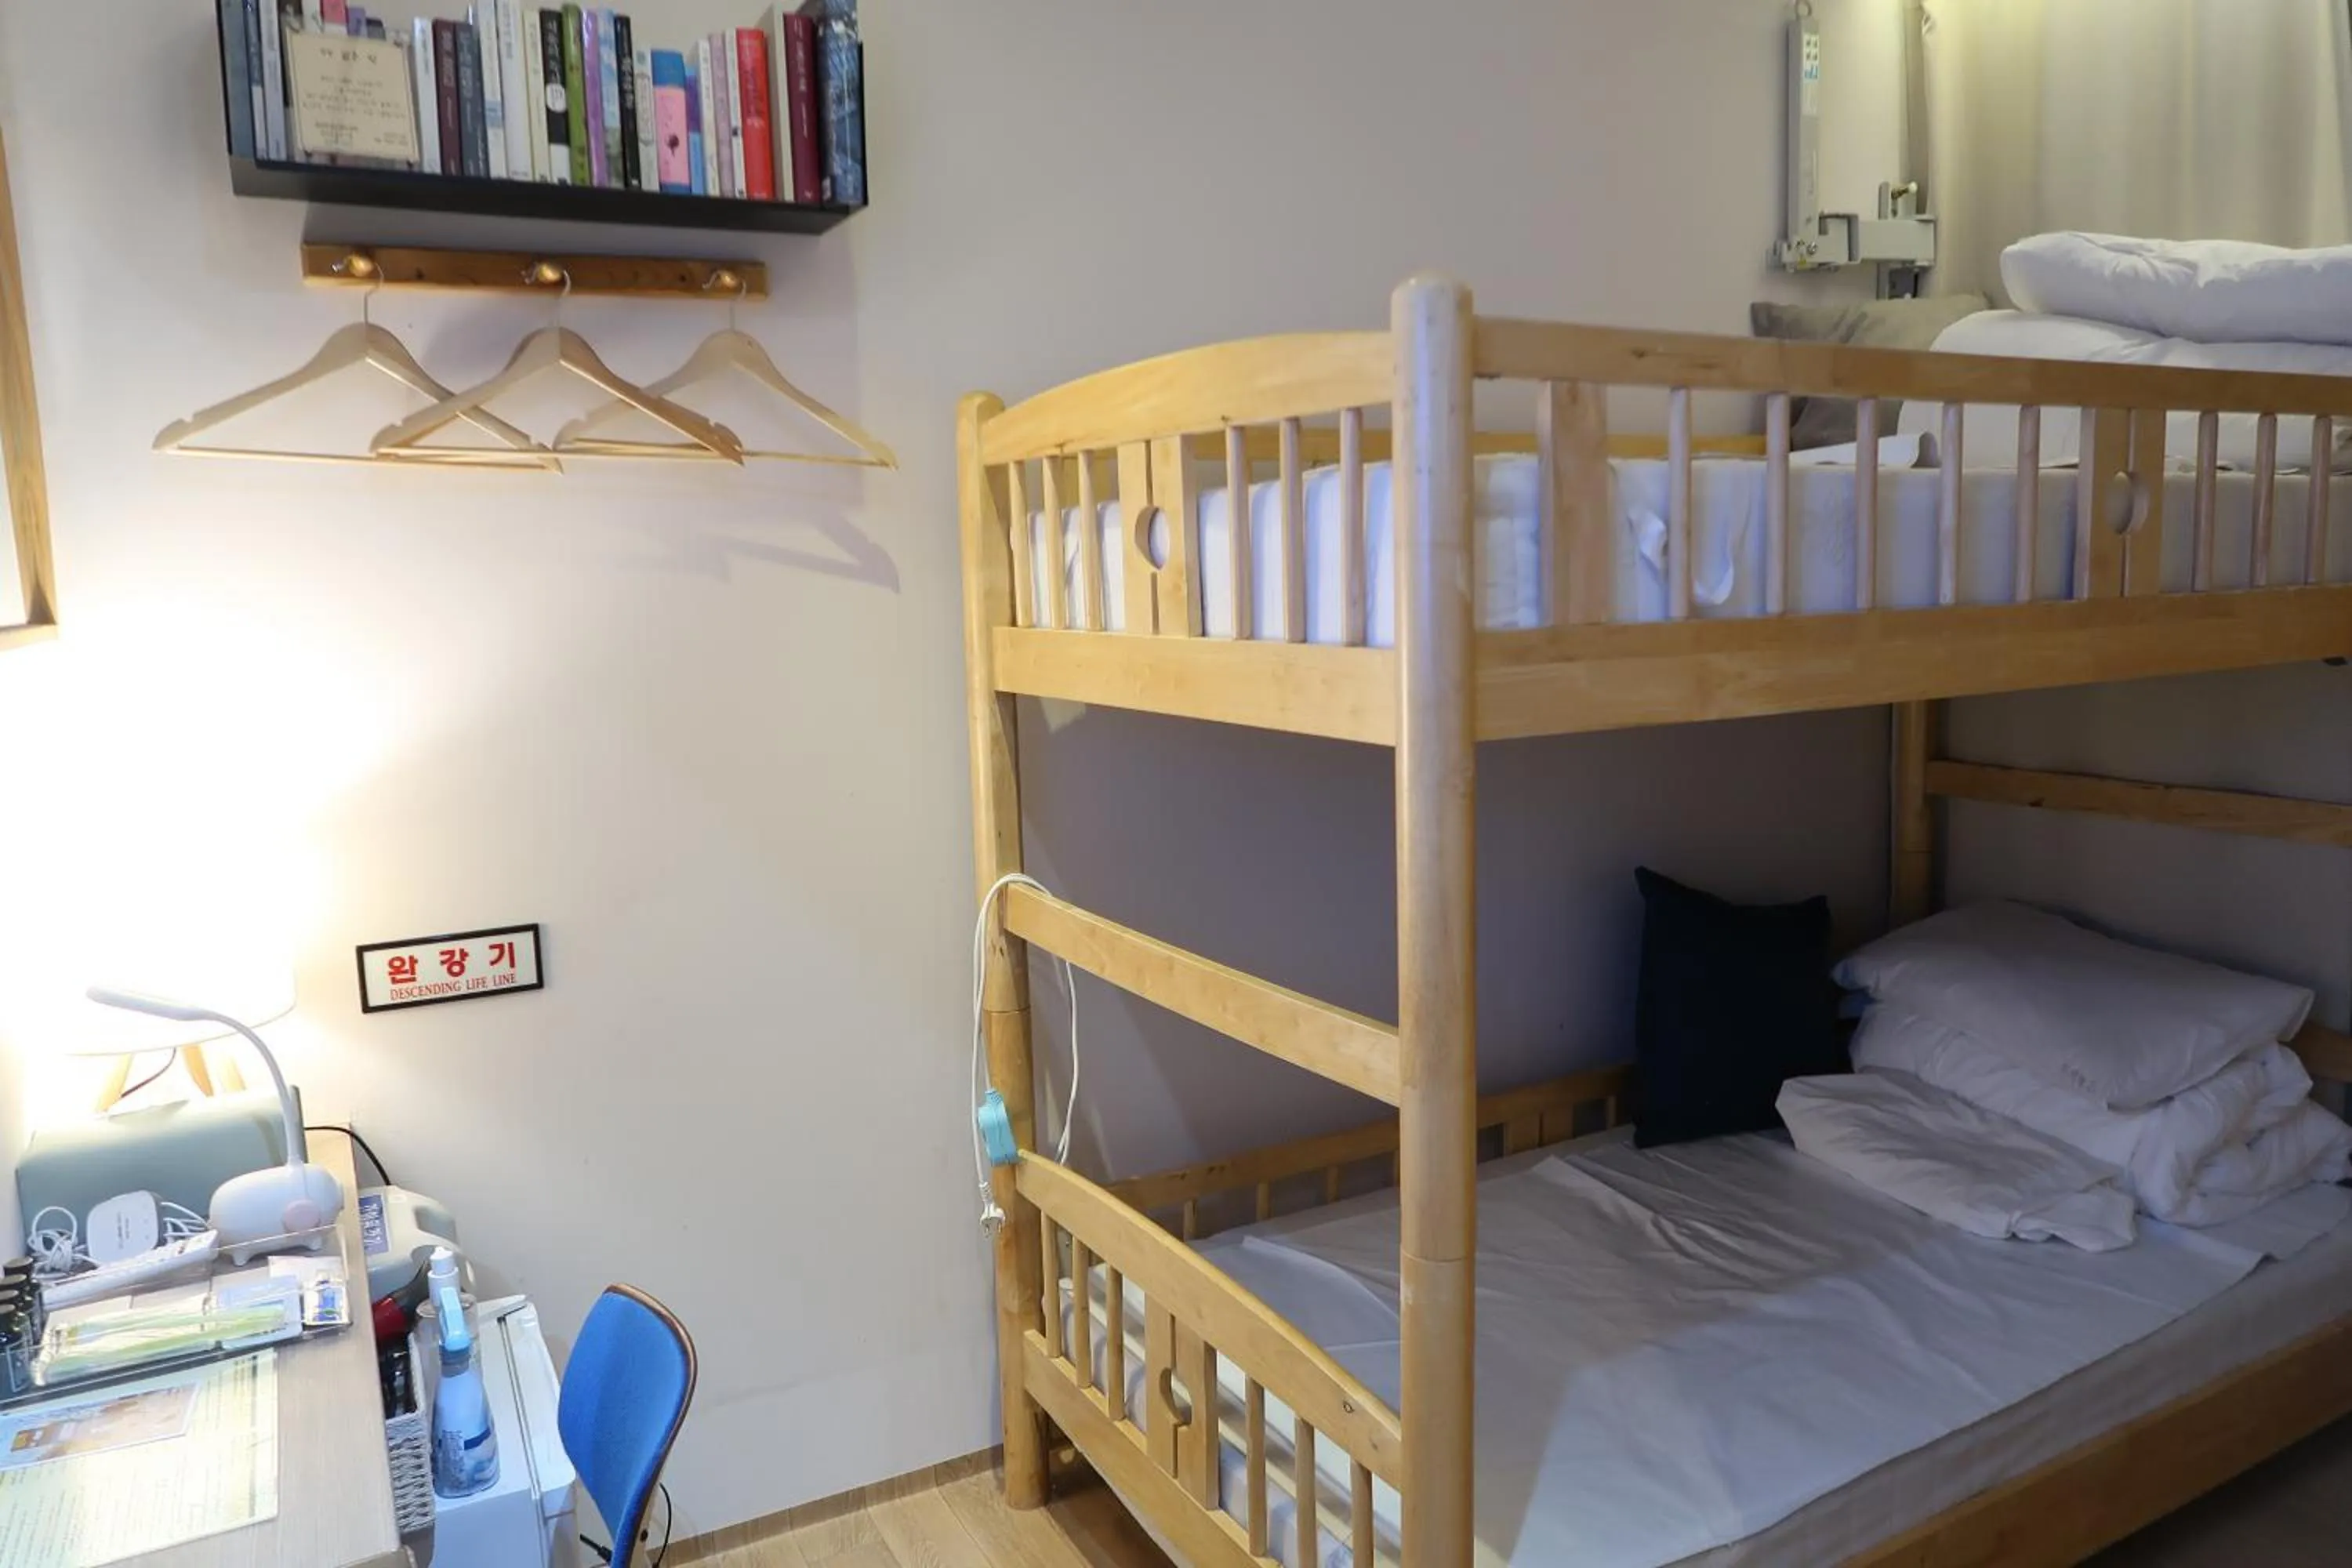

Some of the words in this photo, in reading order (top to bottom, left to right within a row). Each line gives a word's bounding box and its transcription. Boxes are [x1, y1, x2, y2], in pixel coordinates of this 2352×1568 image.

[391, 981, 462, 1000] DESCENDING
[466, 978, 488, 991] LIFE
[493, 973, 517, 986] LINE
